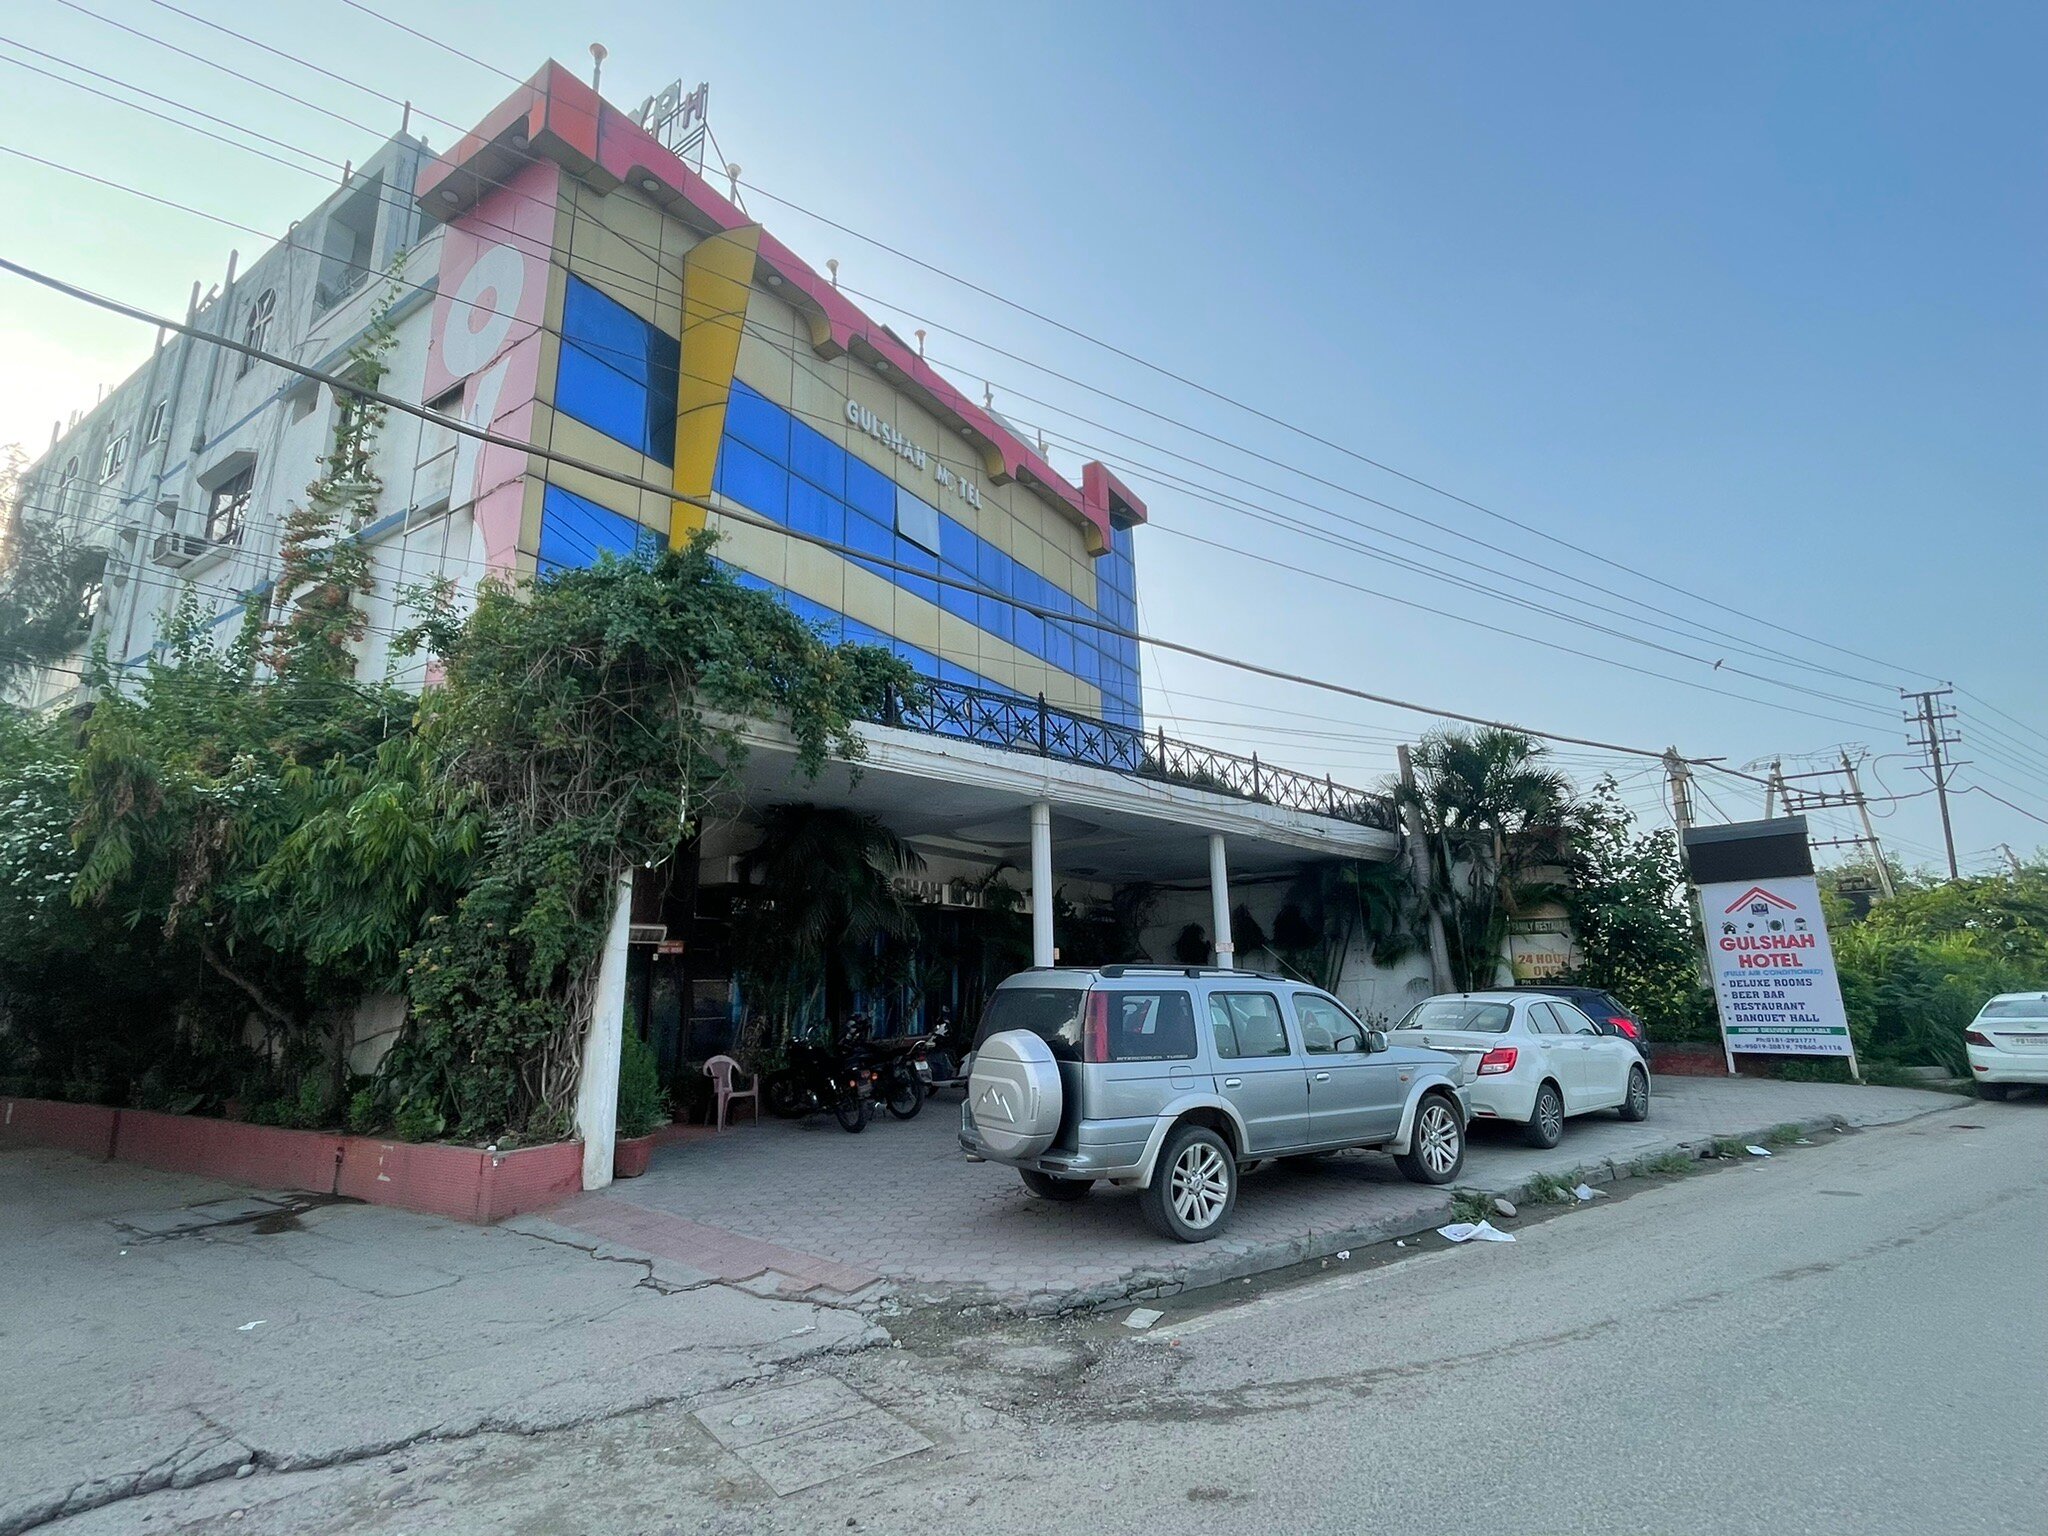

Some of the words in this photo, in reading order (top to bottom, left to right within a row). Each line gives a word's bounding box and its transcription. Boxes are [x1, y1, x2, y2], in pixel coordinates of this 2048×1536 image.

[845, 399, 926, 471] GULSHAH
[1719, 933, 1815, 951] GULSHAH
[1518, 954, 1533, 964] 24
[1738, 952, 1803, 968] HOTEL
[1729, 978, 1770, 987] DELUXE
[1774, 978, 1812, 987] ROOMS
[1731, 990, 1759, 999] BEER
[1763, 990, 1785, 998] BAR
[1733, 1002, 1805, 1011] RESTAURANT
[1735, 1014, 1786, 1022] BANQUET
[1790, 1014, 1819, 1022] HALL
